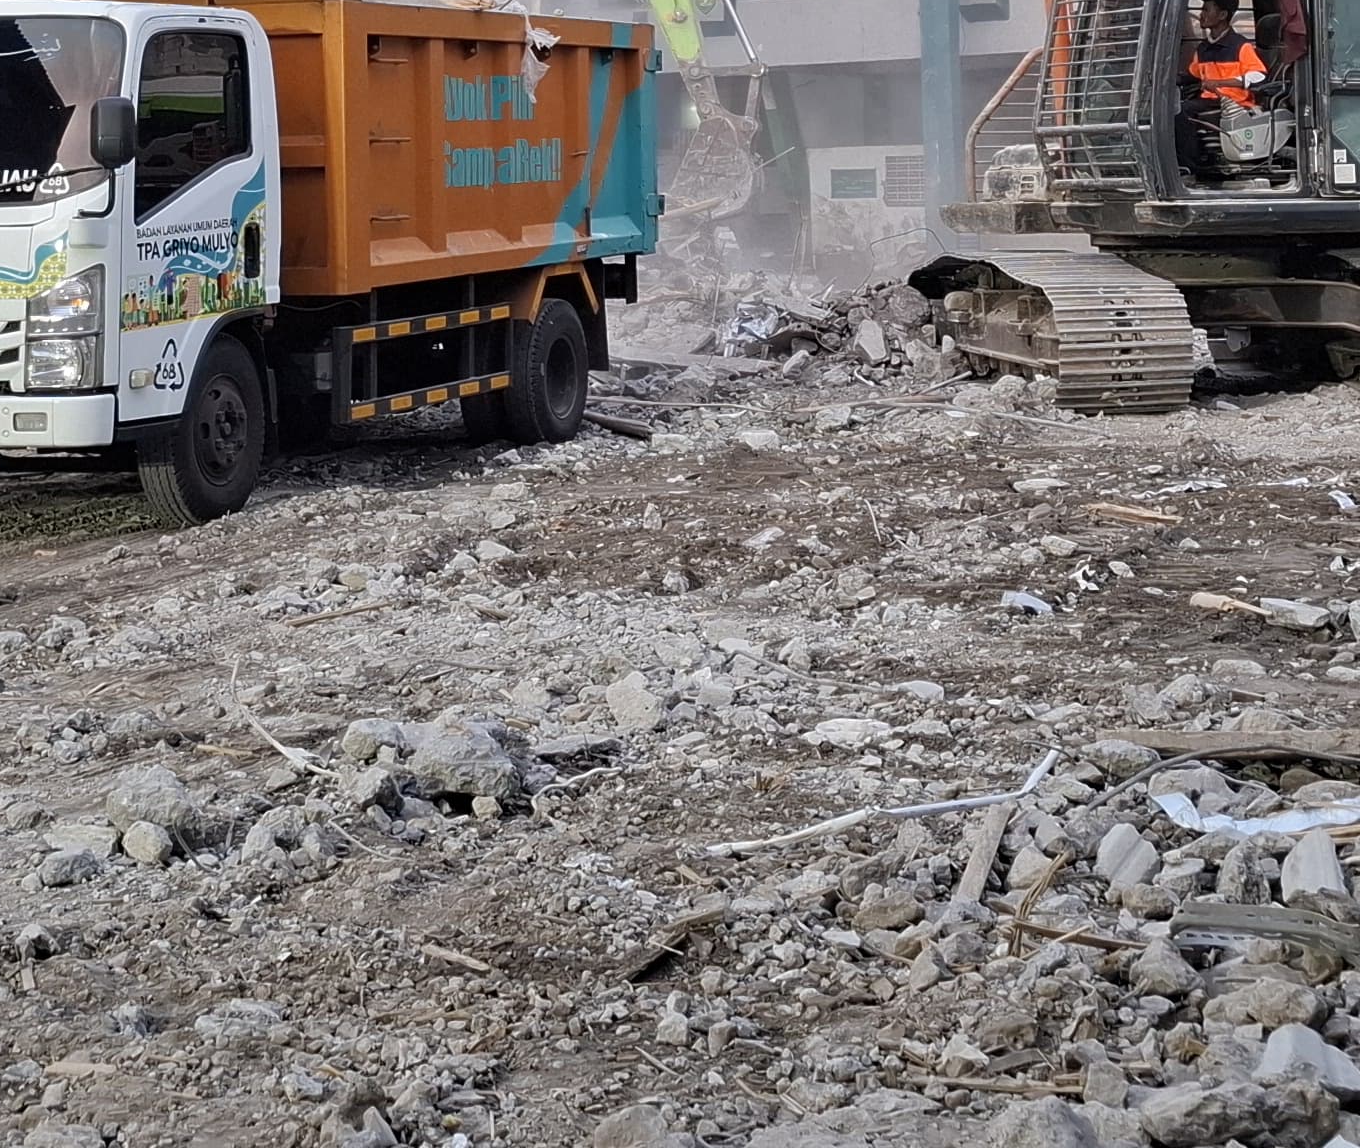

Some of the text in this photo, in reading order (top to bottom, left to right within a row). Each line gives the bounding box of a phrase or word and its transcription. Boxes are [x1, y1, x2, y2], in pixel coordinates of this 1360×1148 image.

[136, 225, 162, 239] BADAN
[162, 222, 192, 236] LAYANAN
[192, 220, 213, 231] UMUM
[136, 231, 239, 261] TPA GRIYO MULYO
[162, 362, 177, 380] 68
